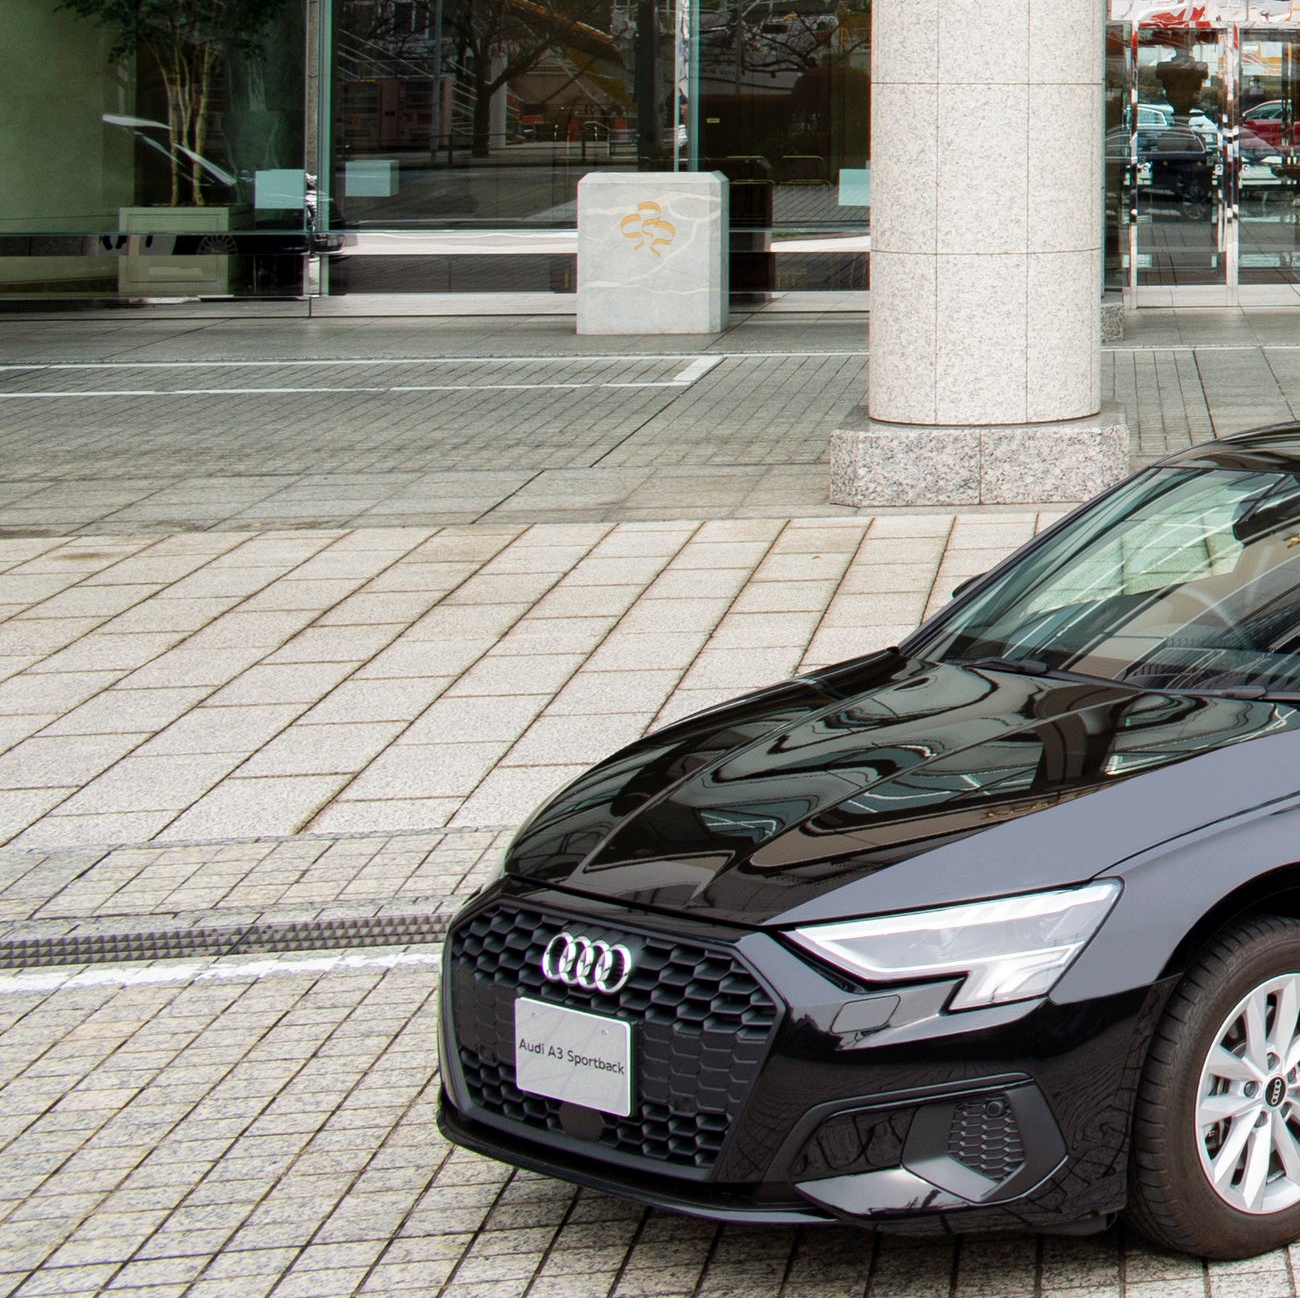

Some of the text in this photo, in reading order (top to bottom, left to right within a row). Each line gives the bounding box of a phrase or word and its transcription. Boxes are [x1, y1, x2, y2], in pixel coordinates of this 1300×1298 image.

[519, 1038, 625, 1076] Audi A3 Sportback
